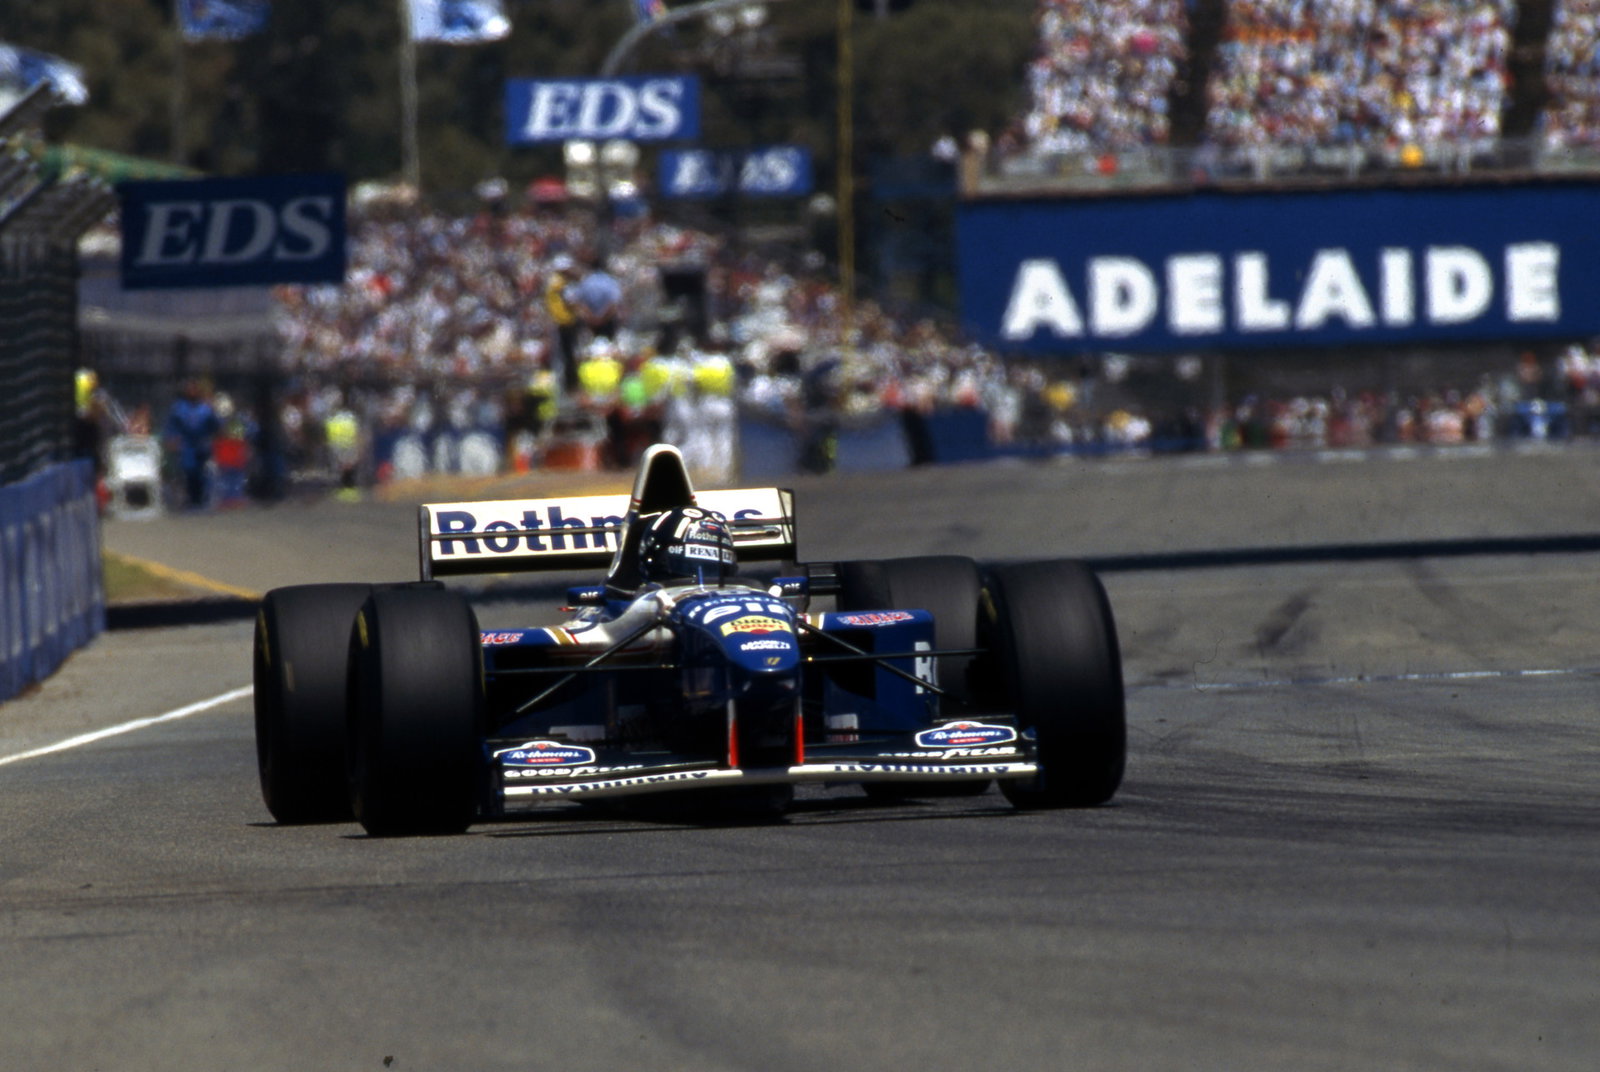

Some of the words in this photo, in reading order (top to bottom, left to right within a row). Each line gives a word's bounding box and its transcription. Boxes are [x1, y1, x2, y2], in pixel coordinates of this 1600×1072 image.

[524, 80, 684, 140] EDS
[134, 197, 334, 266] EDS
[1003, 242, 1561, 340] ADELAIDE
